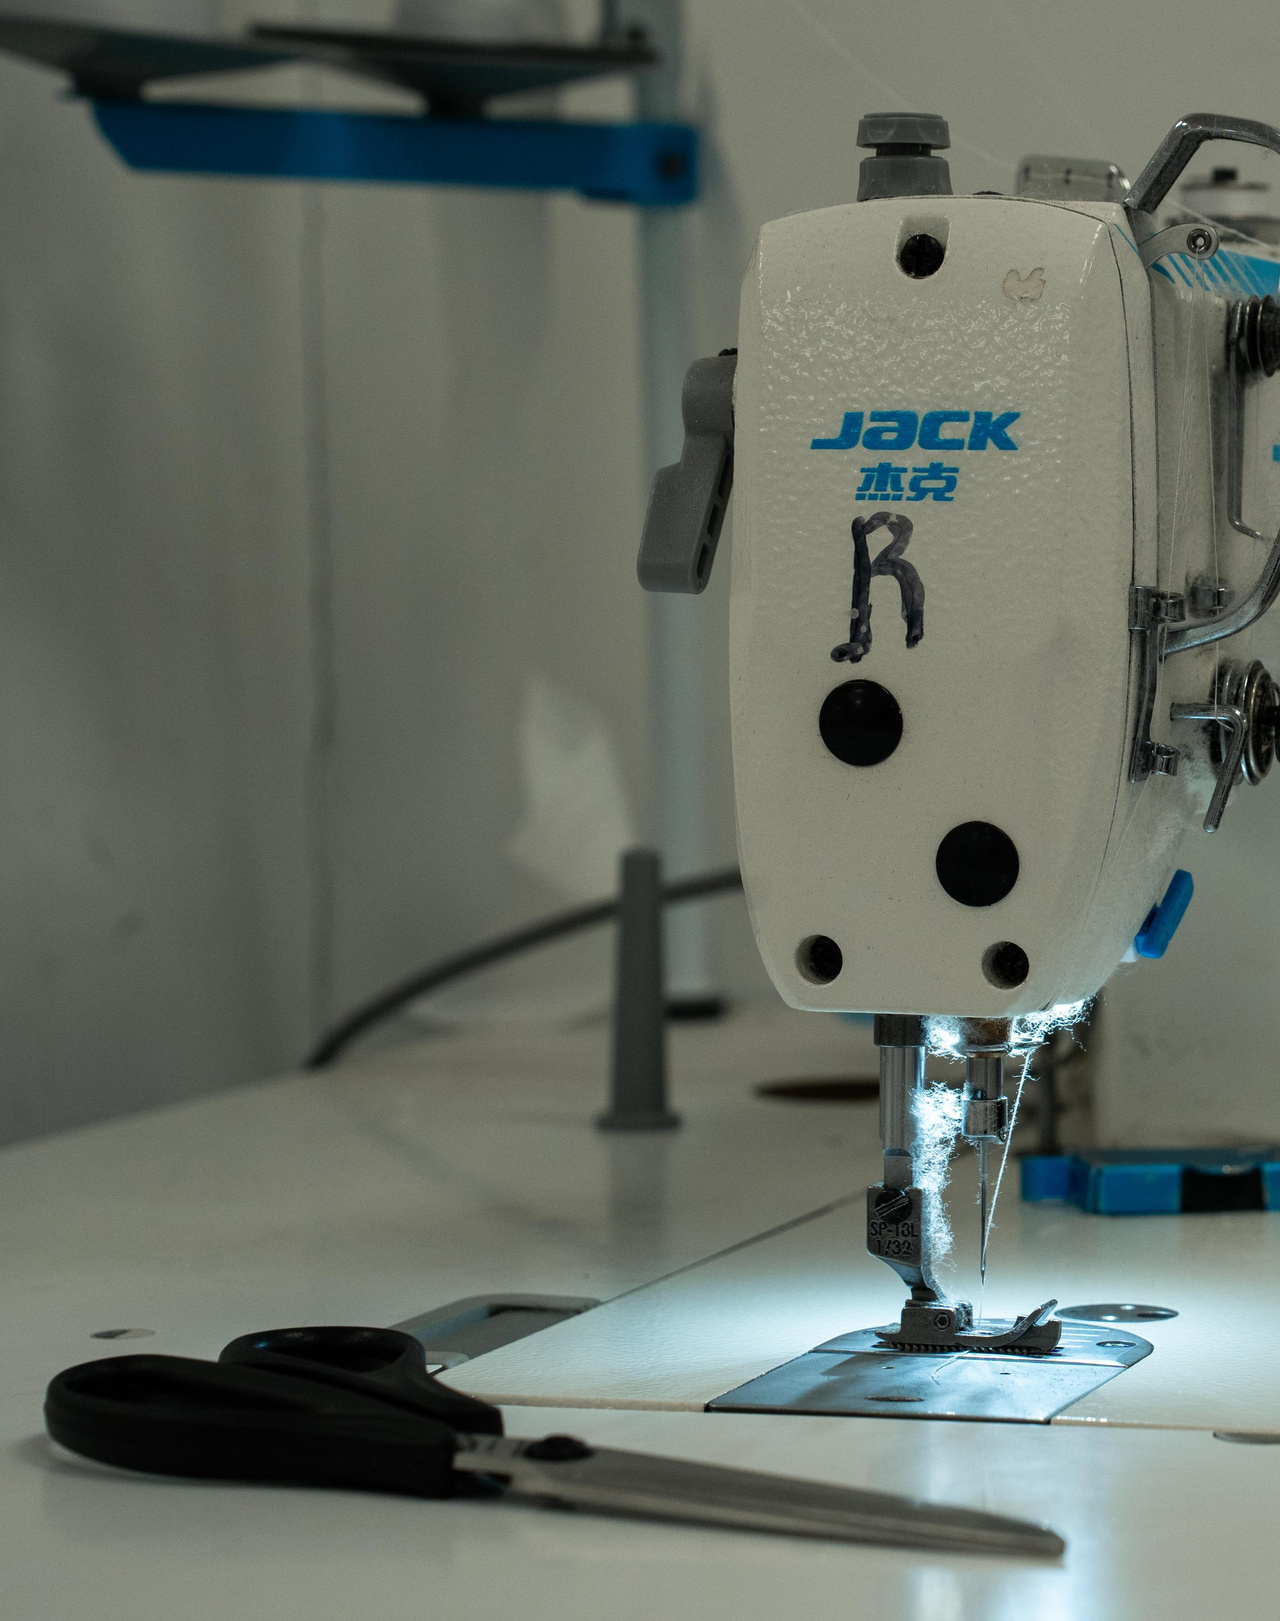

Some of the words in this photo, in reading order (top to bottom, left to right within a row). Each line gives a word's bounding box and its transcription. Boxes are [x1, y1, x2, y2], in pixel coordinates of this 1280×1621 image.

[855, 462, 960, 501] 杰克
[830, 511, 926, 663] R
[876, 1239, 912, 1256] 1/32
